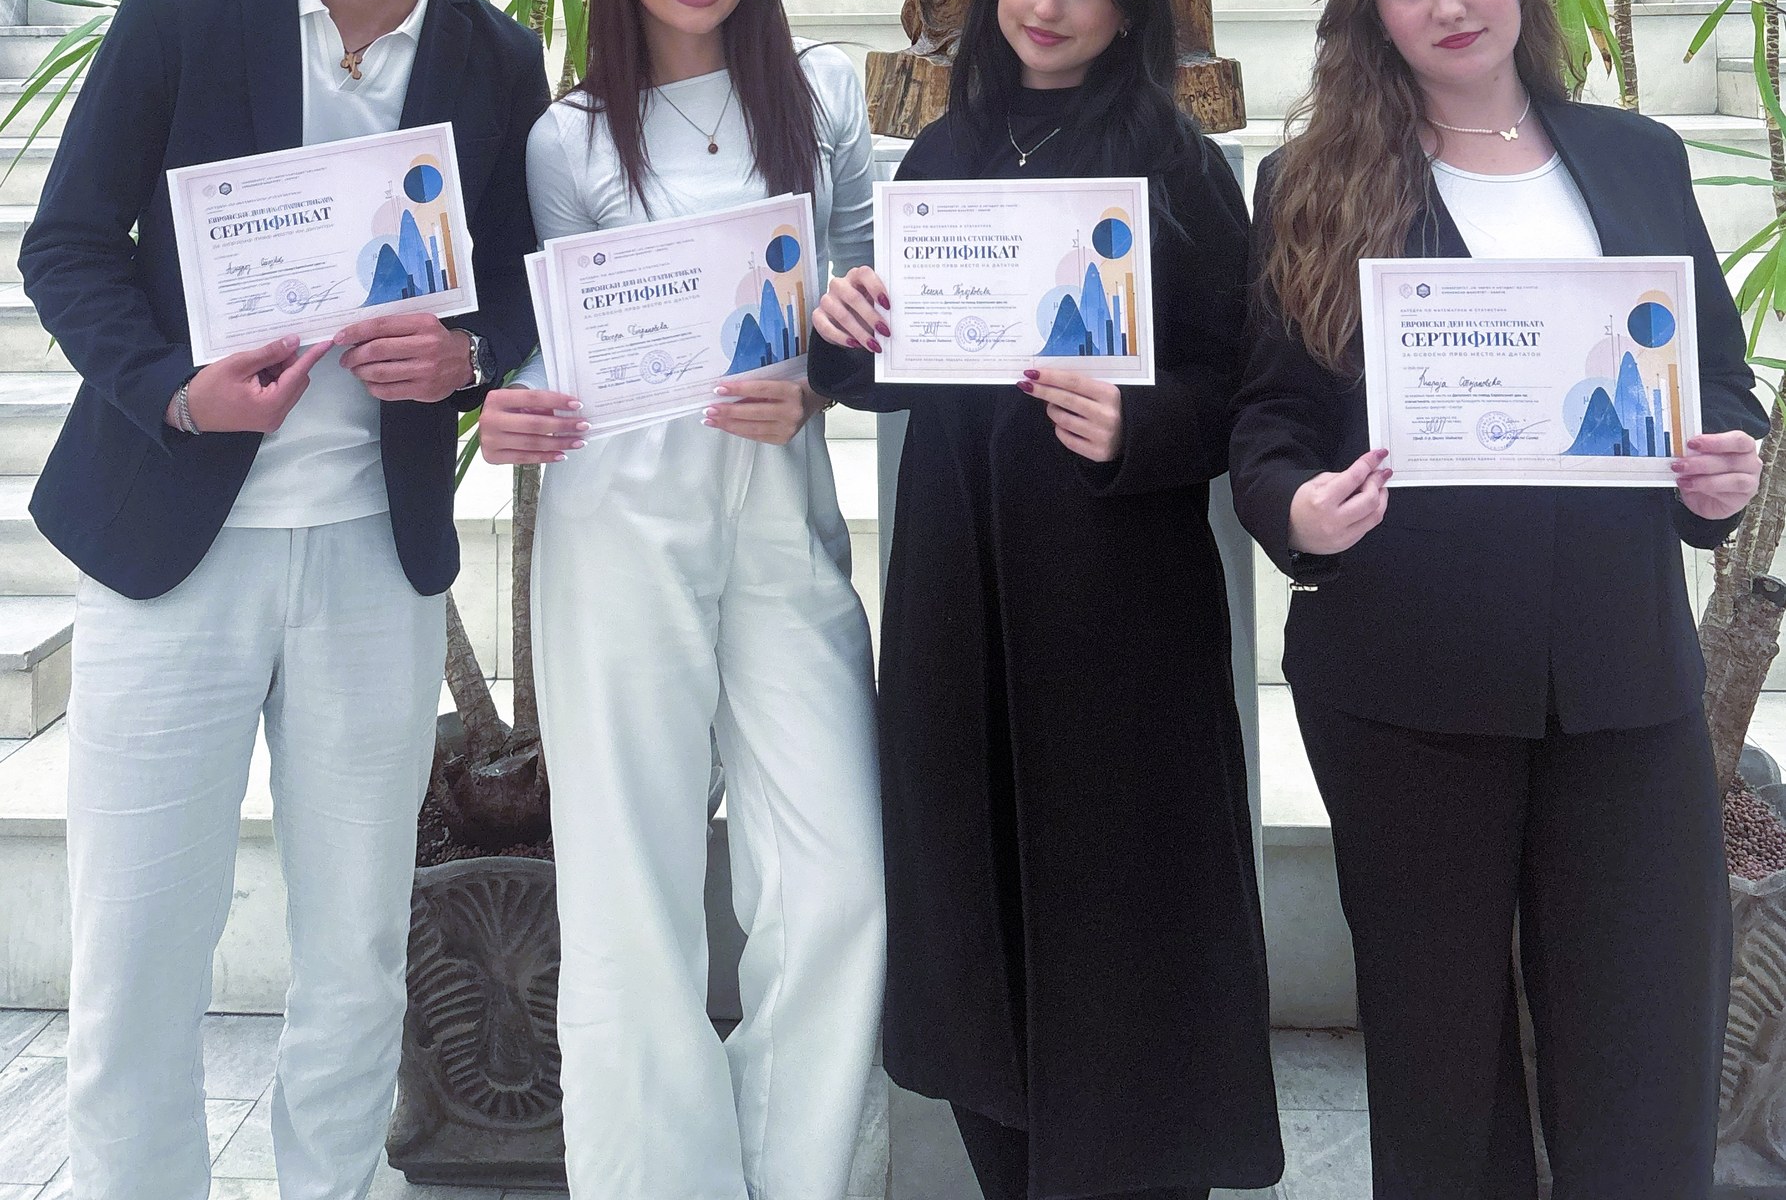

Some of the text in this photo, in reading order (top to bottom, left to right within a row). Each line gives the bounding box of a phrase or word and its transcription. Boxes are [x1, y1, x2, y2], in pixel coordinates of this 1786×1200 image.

[209, 206, 332, 241] СЕРТИФИКАТ
[903, 245, 1020, 260] СЕРТИФИКАТ
[583, 277, 700, 311] СЕРТИФИКАТ
[1401, 330, 1541, 348] СЕРТИФИКАТ
